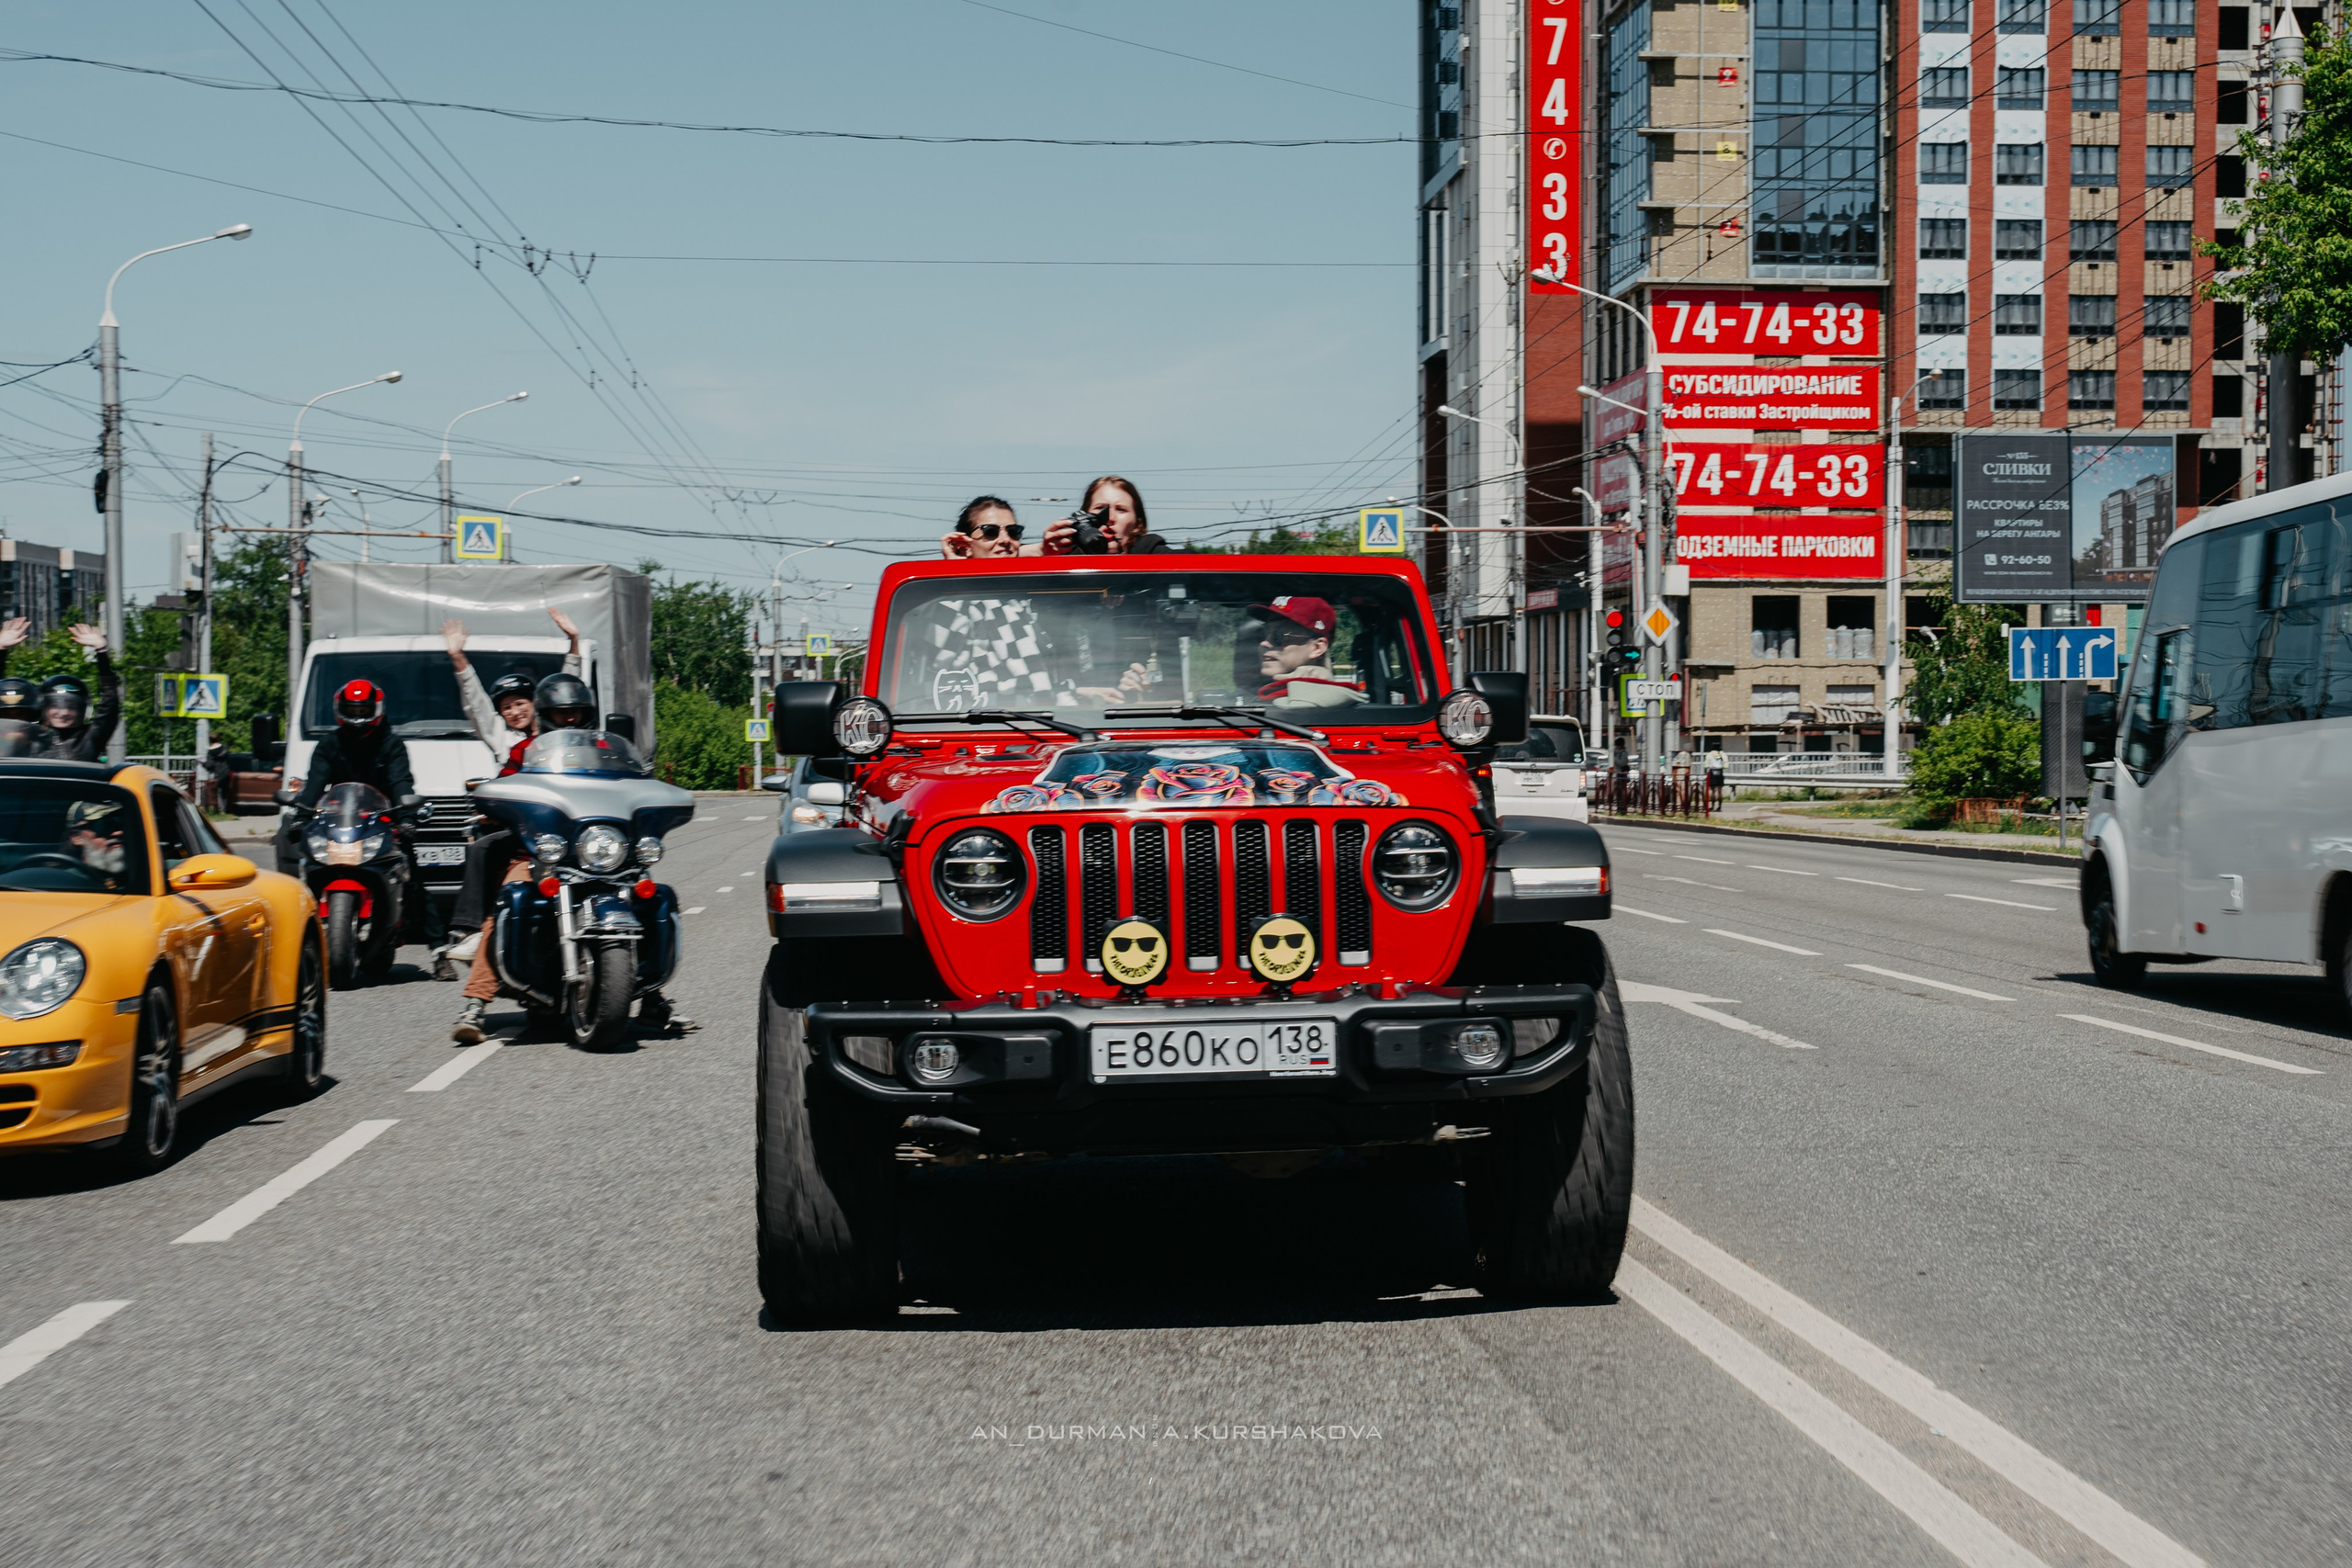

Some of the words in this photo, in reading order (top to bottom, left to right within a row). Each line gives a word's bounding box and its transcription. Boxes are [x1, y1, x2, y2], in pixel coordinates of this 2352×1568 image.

[1667, 300, 1864, 345] 74-74-33
[1668, 374, 1863, 397] СУБСИДИРОВАНИЕ
[1704, 405, 1757, 419] ставки
[1758, 402, 1871, 422] Застройщиком
[1672, 453, 1869, 497] 74-74-33
[1982, 462, 2052, 476] СЛИВКИ
[1966, 500, 2035, 511] РАССРОЧКА
[1994, 519, 2044, 527] КВАРТИРЫ
[1975, 530, 1990, 538] НА
[1991, 530, 2023, 538] БЕРЕГУ
[2023, 530, 2062, 538] АНГАРЫ
[1676, 536, 1778, 558] ОДЗЕМНЫЕ
[1781, 536, 1875, 558] ПАРКОВКИ
[2000, 555, 2052, 565] 92-60-50
[1636, 683, 1673, 696] СТОП
[1267, 1025, 1323, 1054] 138
[1279, 1055, 1308, 1066] RUS
